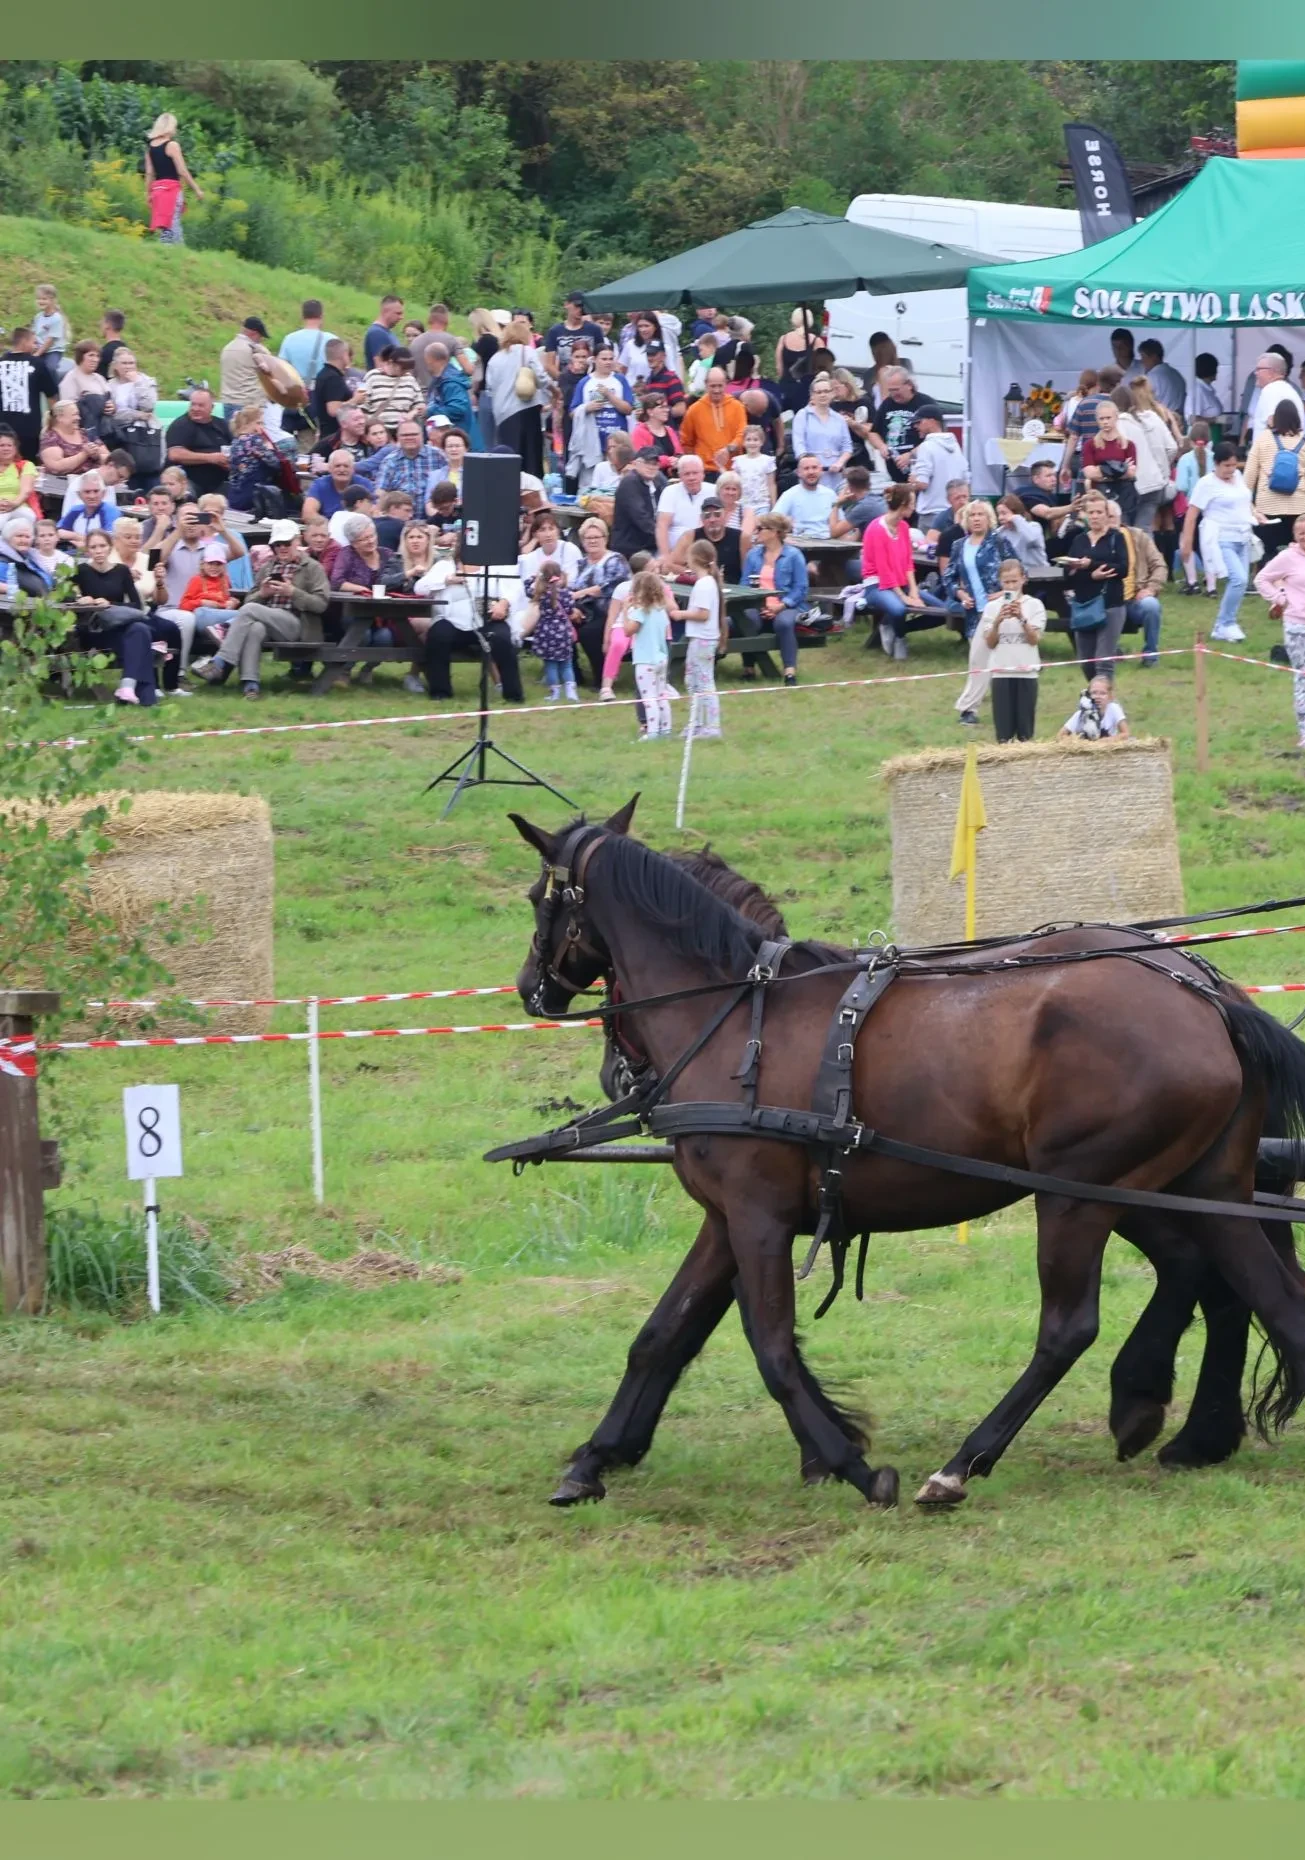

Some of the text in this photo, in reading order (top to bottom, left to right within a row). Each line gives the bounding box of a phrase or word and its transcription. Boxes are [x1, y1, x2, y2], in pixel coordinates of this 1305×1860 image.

[1085, 140, 1112, 216] HORSE
[1071, 286, 1222, 324] SOŁECTWO
[139, 1106, 162, 1158] 8
